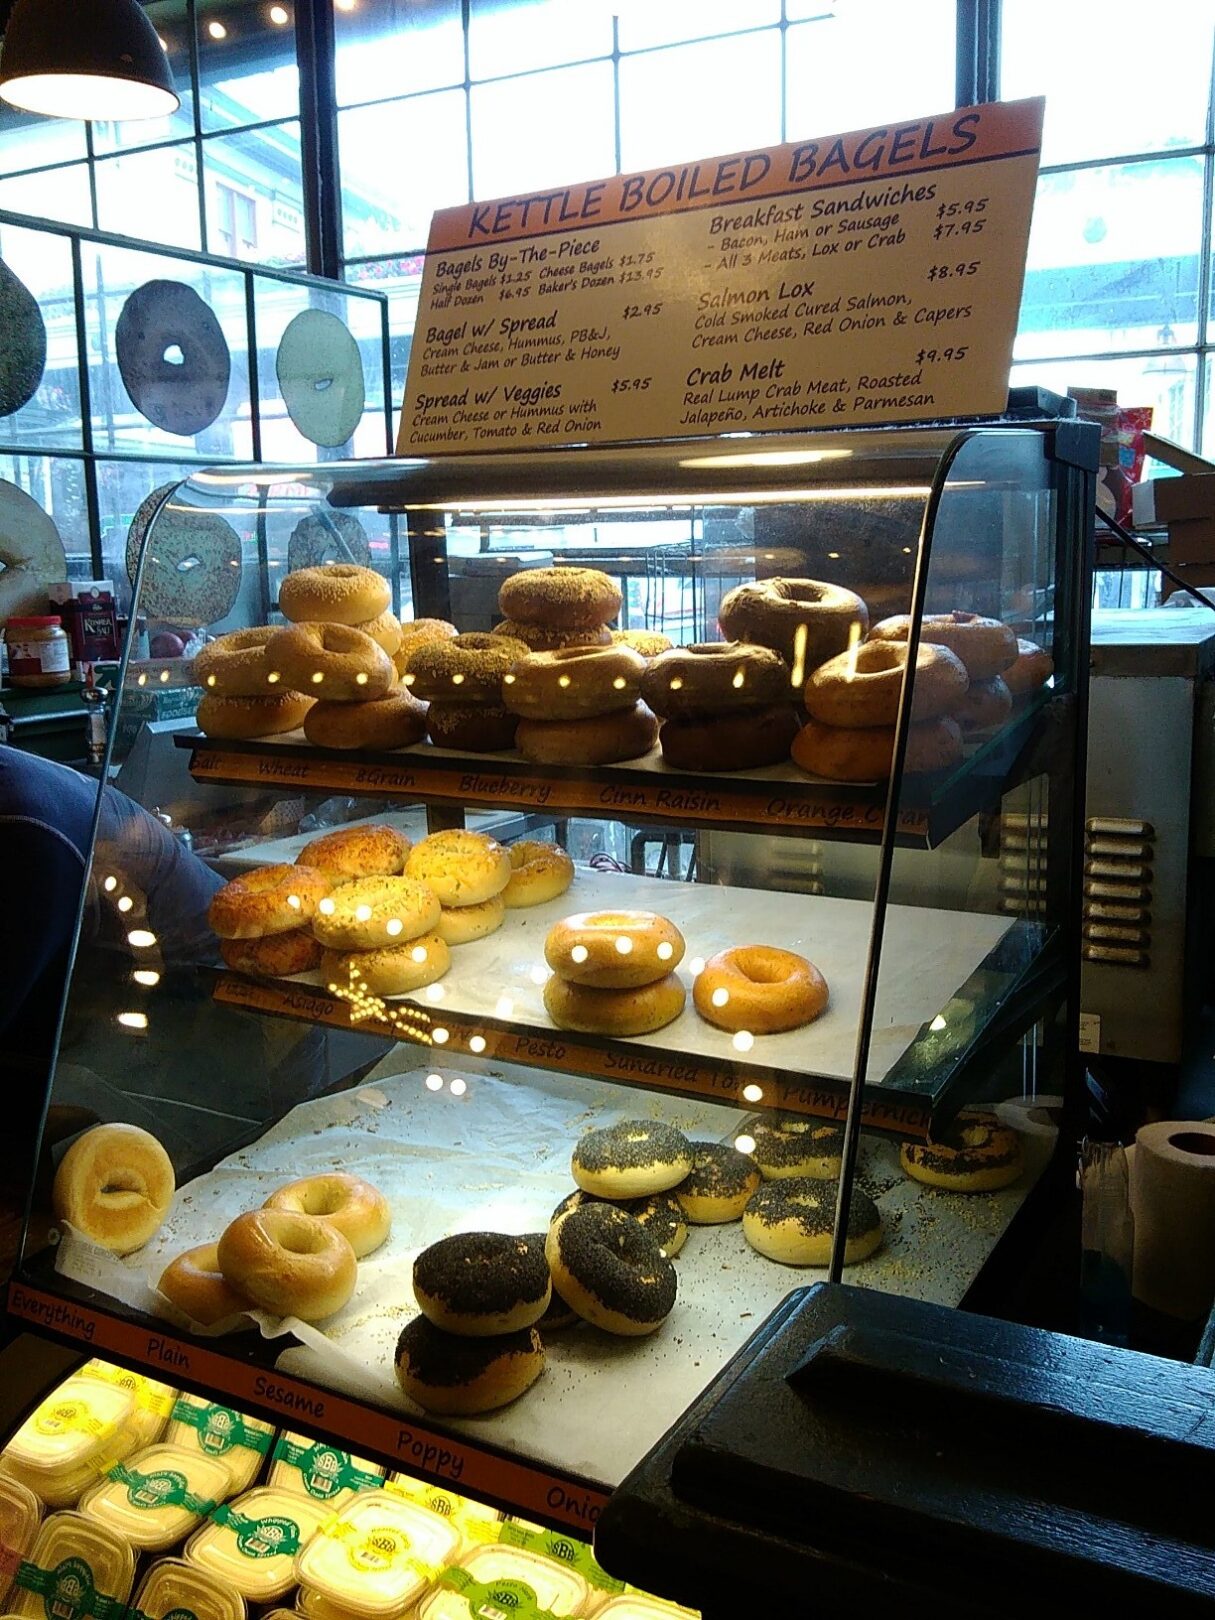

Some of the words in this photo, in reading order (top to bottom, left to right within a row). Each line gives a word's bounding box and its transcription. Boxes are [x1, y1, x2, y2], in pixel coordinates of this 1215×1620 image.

[467, 184, 607, 239] KETTLE
[619, 155, 771, 212] BOILED
[788, 114, 981, 183] BAGELS
[709, 203, 805, 235] Breakfast
[810, 183, 937, 219] Sandwiches
[721, 236, 768, 251] Bacon,
[774, 229, 809, 243] Ham
[816, 224, 833, 236] or
[837, 213, 900, 234] Sausage
[936, 198, 989, 219] $5.95
[436, 254, 483, 279] Bagels
[488, 239, 601, 272] By-The-Piece
[716, 255, 738, 271] All
[742, 255, 752, 266] 3
[758, 246, 806, 264] Meats,
[812, 242, 840, 257] Lox
[844, 239, 863, 252] or
[867, 228, 906, 249] Crab
[933, 219, 987, 240] $7.95
[430, 297, 452, 311] Half
[454, 295, 484, 307] Dozen
[499, 286, 532, 301] $6.95
[538, 279, 577, 295] Baker's
[581, 276, 615, 289] Dozen
[619, 267, 664, 284] $13.95
[433, 281, 462, 296] Single
[465, 275, 497, 291] Bagels
[500, 271, 532, 286] $1.25
[539, 265, 576, 279] Cheese
[579, 256, 614, 274] Bagels
[619, 252, 656, 267] $1.75
[697, 287, 770, 311] Salmon
[778, 281, 815, 300] Lox
[927, 261, 981, 281] $8.95
[426, 321, 468, 346] Bagel
[472, 319, 496, 338] w/
[499, 310, 559, 340] Spread
[622, 302, 663, 320] $2.95
[691, 334, 738, 349] Cream
[744, 325, 797, 343] Cheese,
[803, 318, 834, 336] Red
[839, 314, 886, 332] Onion
[893, 311, 908, 326] &
[914, 305, 972, 326] Capers
[694, 311, 727, 330] Cold
[731, 303, 790, 325] Smoked
[794, 296, 842, 318] Cured
[846, 293, 913, 312] Salmon,
[420, 363, 457, 377] Butter
[460, 360, 470, 373] &
[474, 358, 499, 371] Jam
[504, 357, 517, 367] or
[521, 352, 561, 366] Butter
[565, 348, 576, 361] &
[581, 346, 621, 360] Honey
[423, 347, 459, 360] Cream
[463, 341, 503, 356] Cheese,
[508, 335, 566, 350] Hummus,
[570, 326, 611, 344] PB&J,
[686, 362, 732, 387] Crab
[739, 358, 786, 382] Melt
[915, 346, 969, 366] $9.95
[415, 387, 469, 415] Spread
[475, 386, 498, 404] w/
[504, 381, 562, 405] Veggies
[612, 377, 652, 393] $5.95
[683, 388, 714, 405] Real
[718, 388, 760, 406] Lump
[765, 380, 802, 399] Crab
[806, 378, 851, 395] Meat,
[857, 369, 923, 391] Roasted
[412, 414, 448, 427] Cream
[452, 409, 489, 424] Cheese
[493, 410, 507, 420] or
[510, 404, 564, 418] Hummus
[569, 399, 597, 414] with
[680, 407, 747, 427] Jalapeño,
[752, 399, 826, 419] Artichoke
[832, 398, 847, 413] &
[853, 393, 935, 411] Parmesan
[410, 427, 468, 444] Cucumber,
[473, 422, 517, 439] Tomato
[522, 422, 533, 436] &
[536, 420, 561, 435] Red
[564, 417, 602, 432] Onion
[257, 759, 310, 779] Wheat
[458, 774, 551, 802] Blueberry
[599, 785, 647, 807] Cinn
[655, 788, 722, 811] Raisin
[767, 799, 855, 826] Orange
[282, 992, 334, 1018] Asiago
[513, 1037, 566, 1060] Pesto
[604, 1051, 699, 1083] Sundried
[12, 1289, 96, 1341] Everything
[146, 1337, 191, 1370] Plain
[253, 1376, 326, 1418] Sesame
[397, 1430, 465, 1478] Poppy
[546, 1486, 600, 1523] Onio
